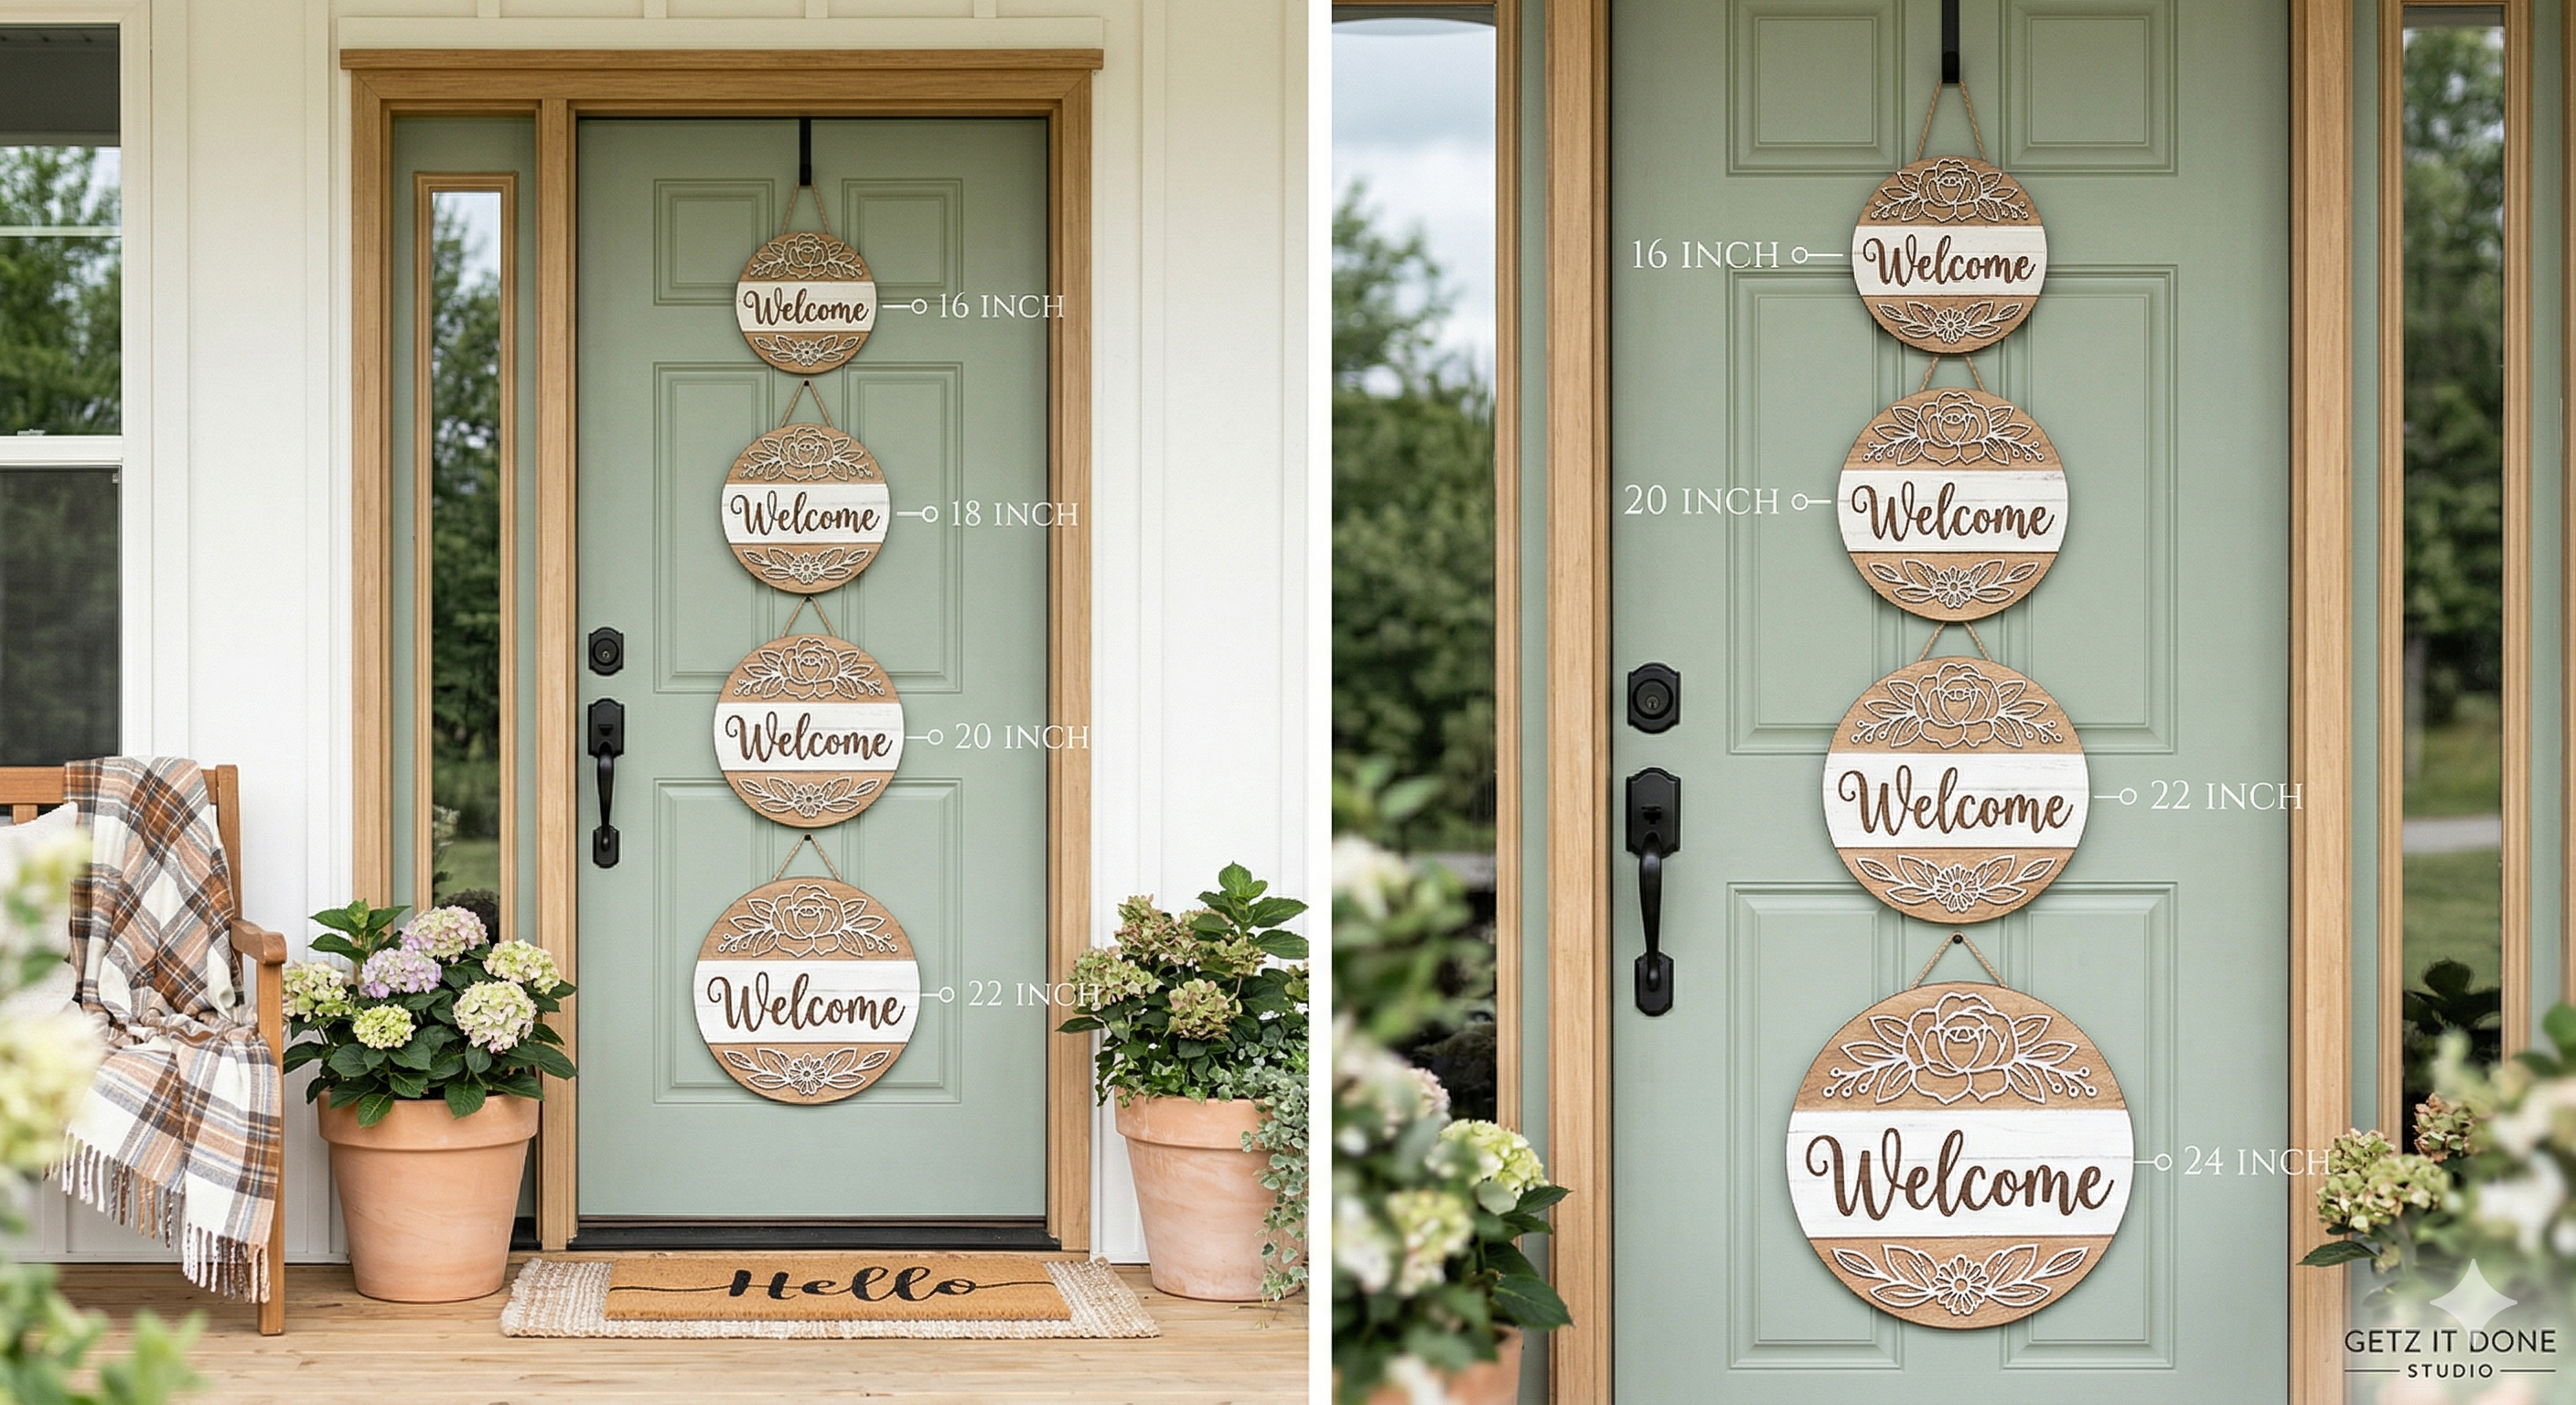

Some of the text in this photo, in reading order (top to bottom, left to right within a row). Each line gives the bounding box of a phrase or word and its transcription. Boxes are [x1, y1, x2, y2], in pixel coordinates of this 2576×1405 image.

[1862, 234, 2036, 286] Welcome
[743, 287, 869, 326] Welcome
[730, 491, 880, 535] Welcome
[1852, 481, 2055, 541] Welcome
[724, 711, 893, 763] Welcome
[1838, 765, 2074, 836] Welcome
[707, 971, 906, 1032] Welcome
[1806, 1128, 2114, 1221] Welcome
[728, 1266, 978, 1302] Hello
